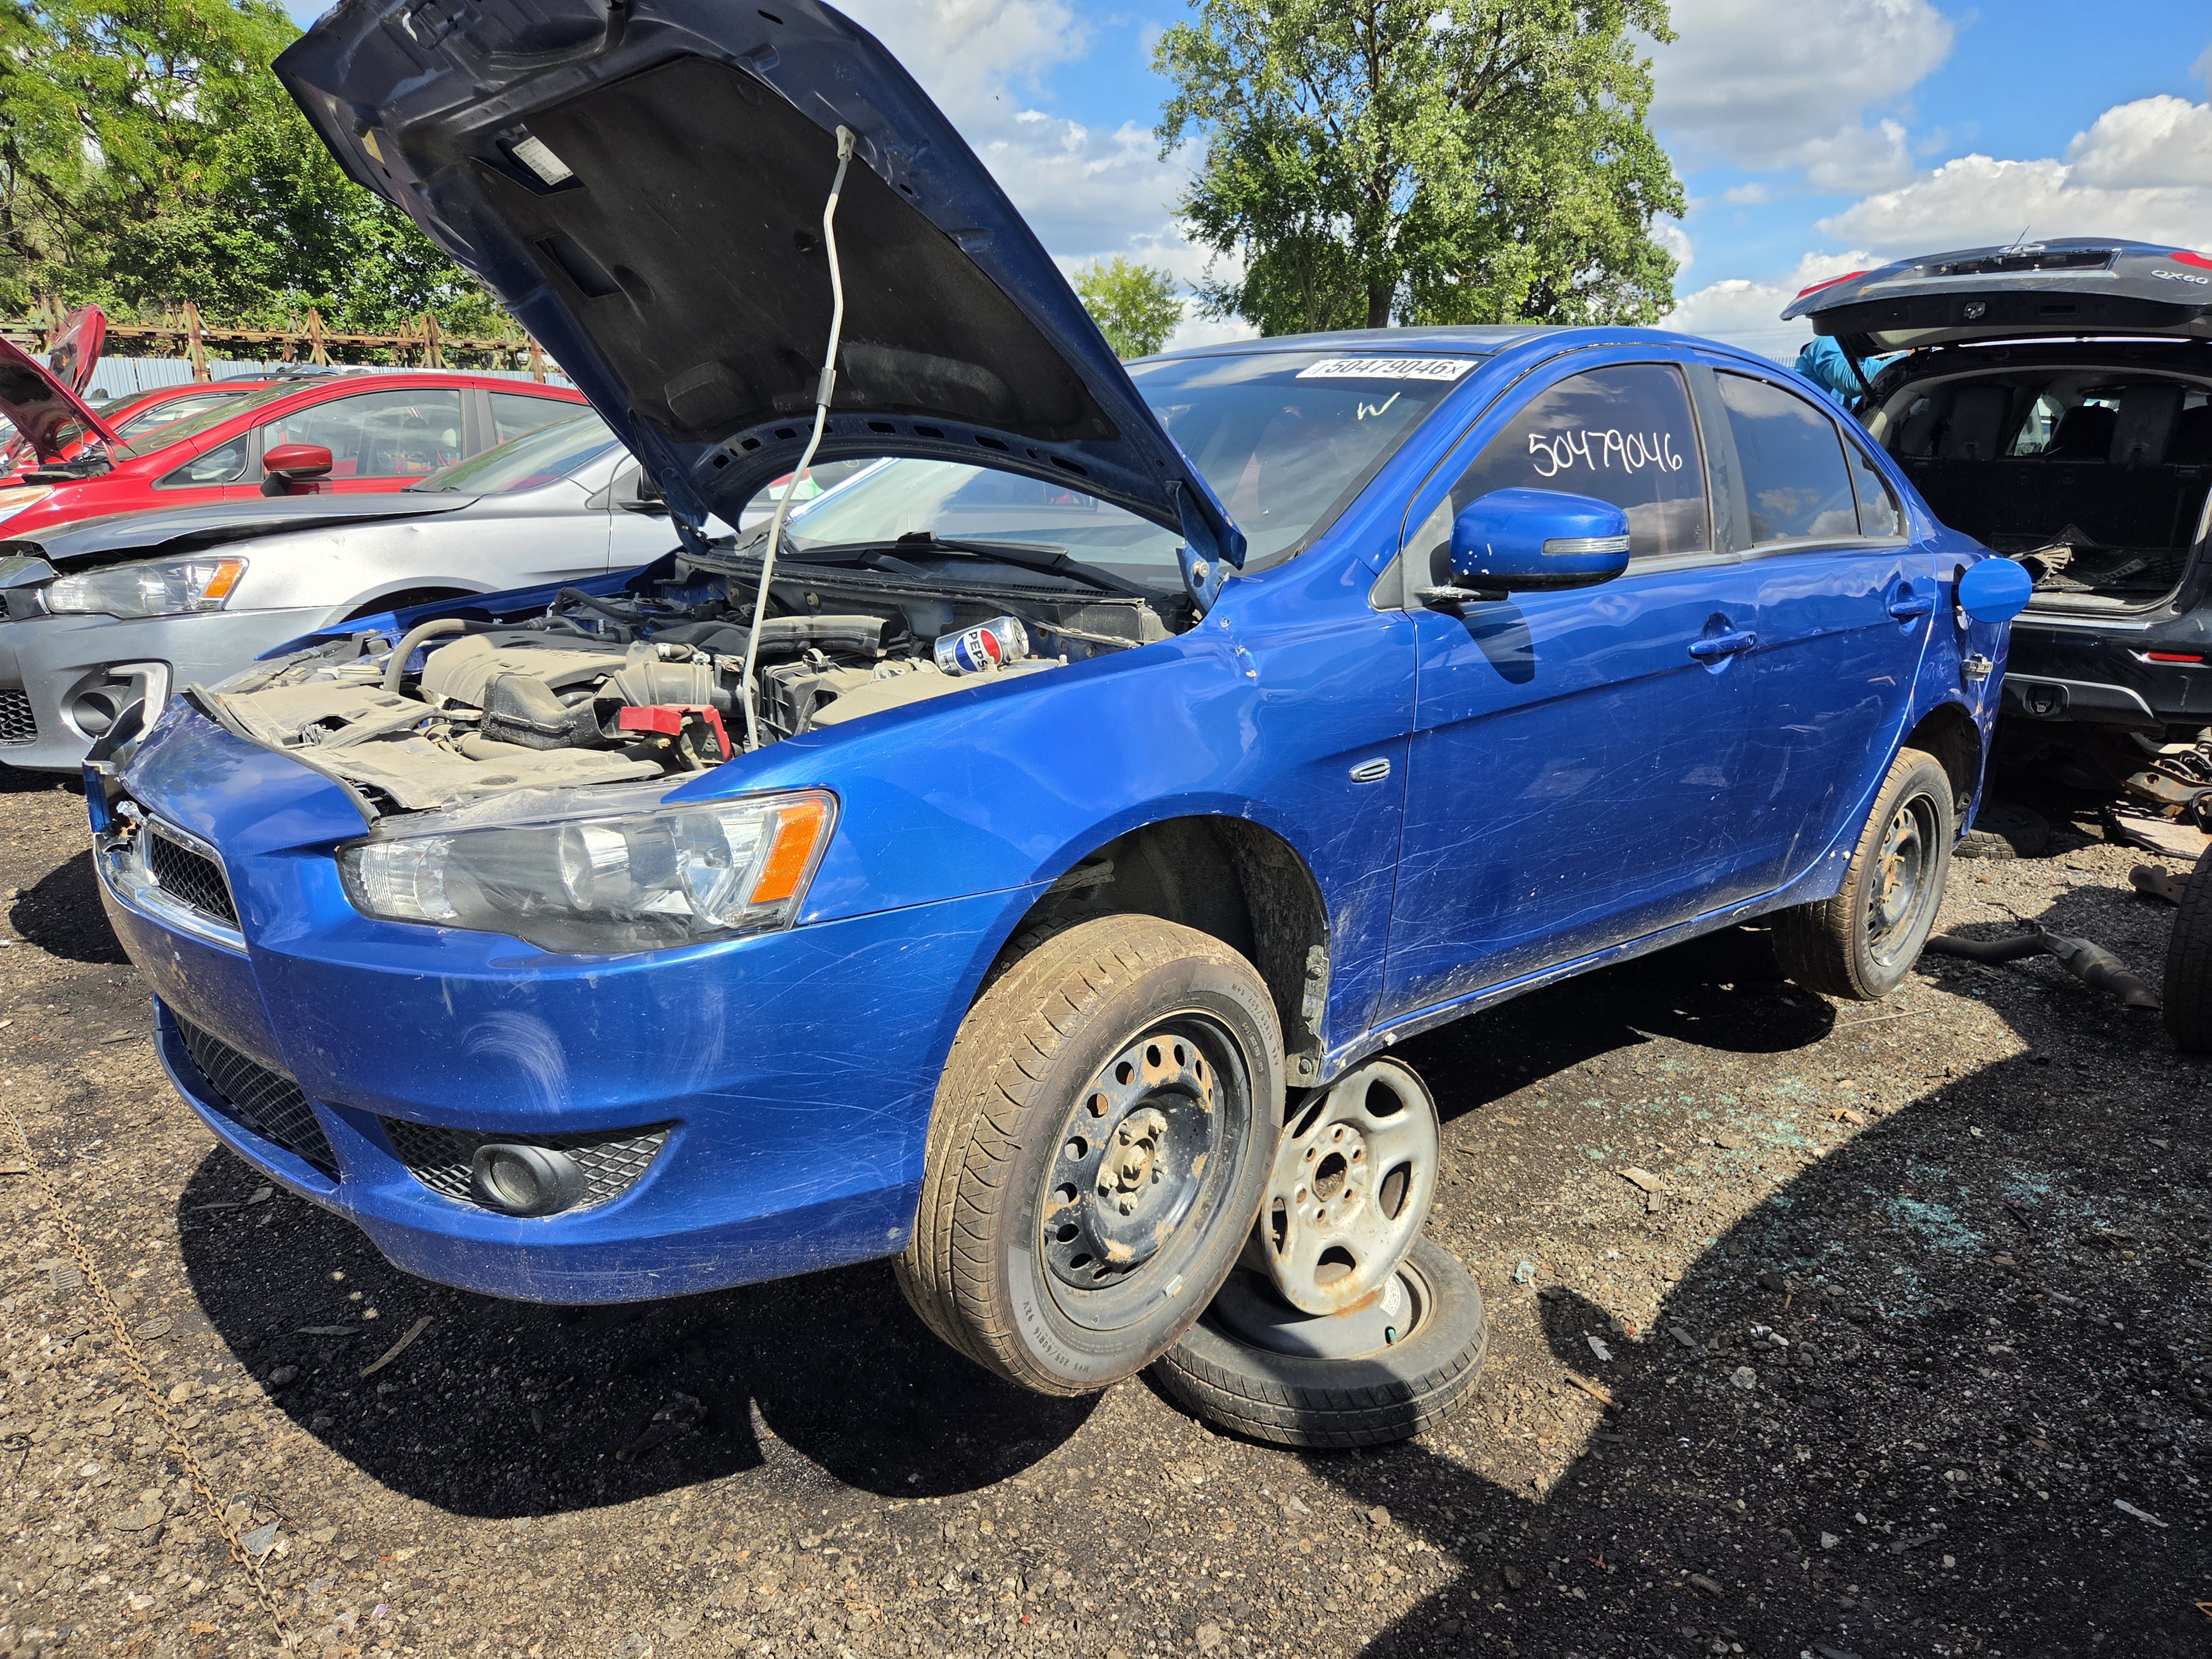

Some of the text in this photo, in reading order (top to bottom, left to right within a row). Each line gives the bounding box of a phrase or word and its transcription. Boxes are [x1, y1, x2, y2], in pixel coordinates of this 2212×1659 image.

[2151, 270, 2208, 285] QX60
[1528, 429, 1683, 477] 50479046
[943, 655, 952, 670] DIET
[969, 631, 988, 670] PEPS
[1248, 995, 1273, 1041] 205/60R16
[1023, 1301, 1035, 1322] 92V
[1032, 1326, 1070, 1366] 205/60R16
